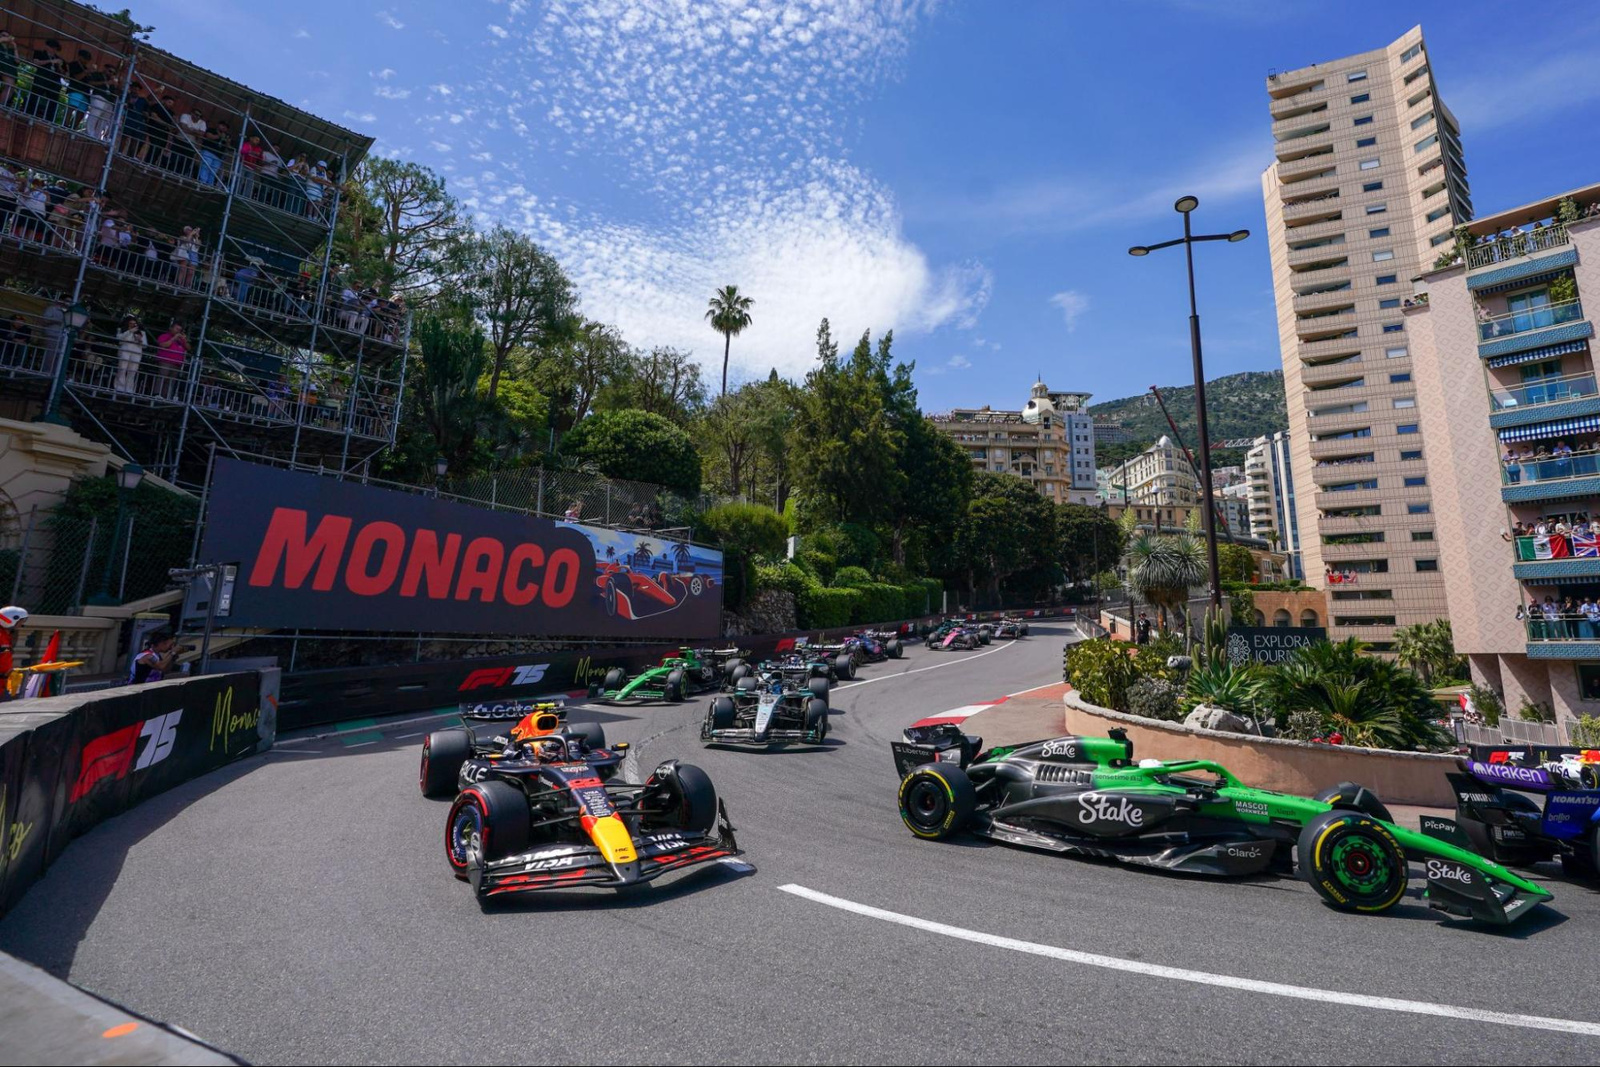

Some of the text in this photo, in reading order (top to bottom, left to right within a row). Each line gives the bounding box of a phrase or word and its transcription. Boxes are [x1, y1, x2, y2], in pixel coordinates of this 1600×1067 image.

[248, 506, 581, 608] MONACO
[1254, 635, 1311, 648] EXPLORA
[1255, 649, 1295, 663] JOURN
[511, 663, 550, 686] 75
[133, 708, 183, 772] 75
[1041, 741, 1076, 758] Stake
[1487, 763, 1544, 784] kraken
[1549, 763, 1571, 779] VISA
[1235, 800, 1268, 811] MASCOT
[1552, 795, 1600, 805] KOMATSU
[1078, 792, 1144, 827] Stake
[1236, 808, 1268, 816] WORKWEAR
[1424, 820, 1456, 833] PicPay
[1227, 848, 1256, 858] Claro
[1427, 860, 1472, 884] Stake
